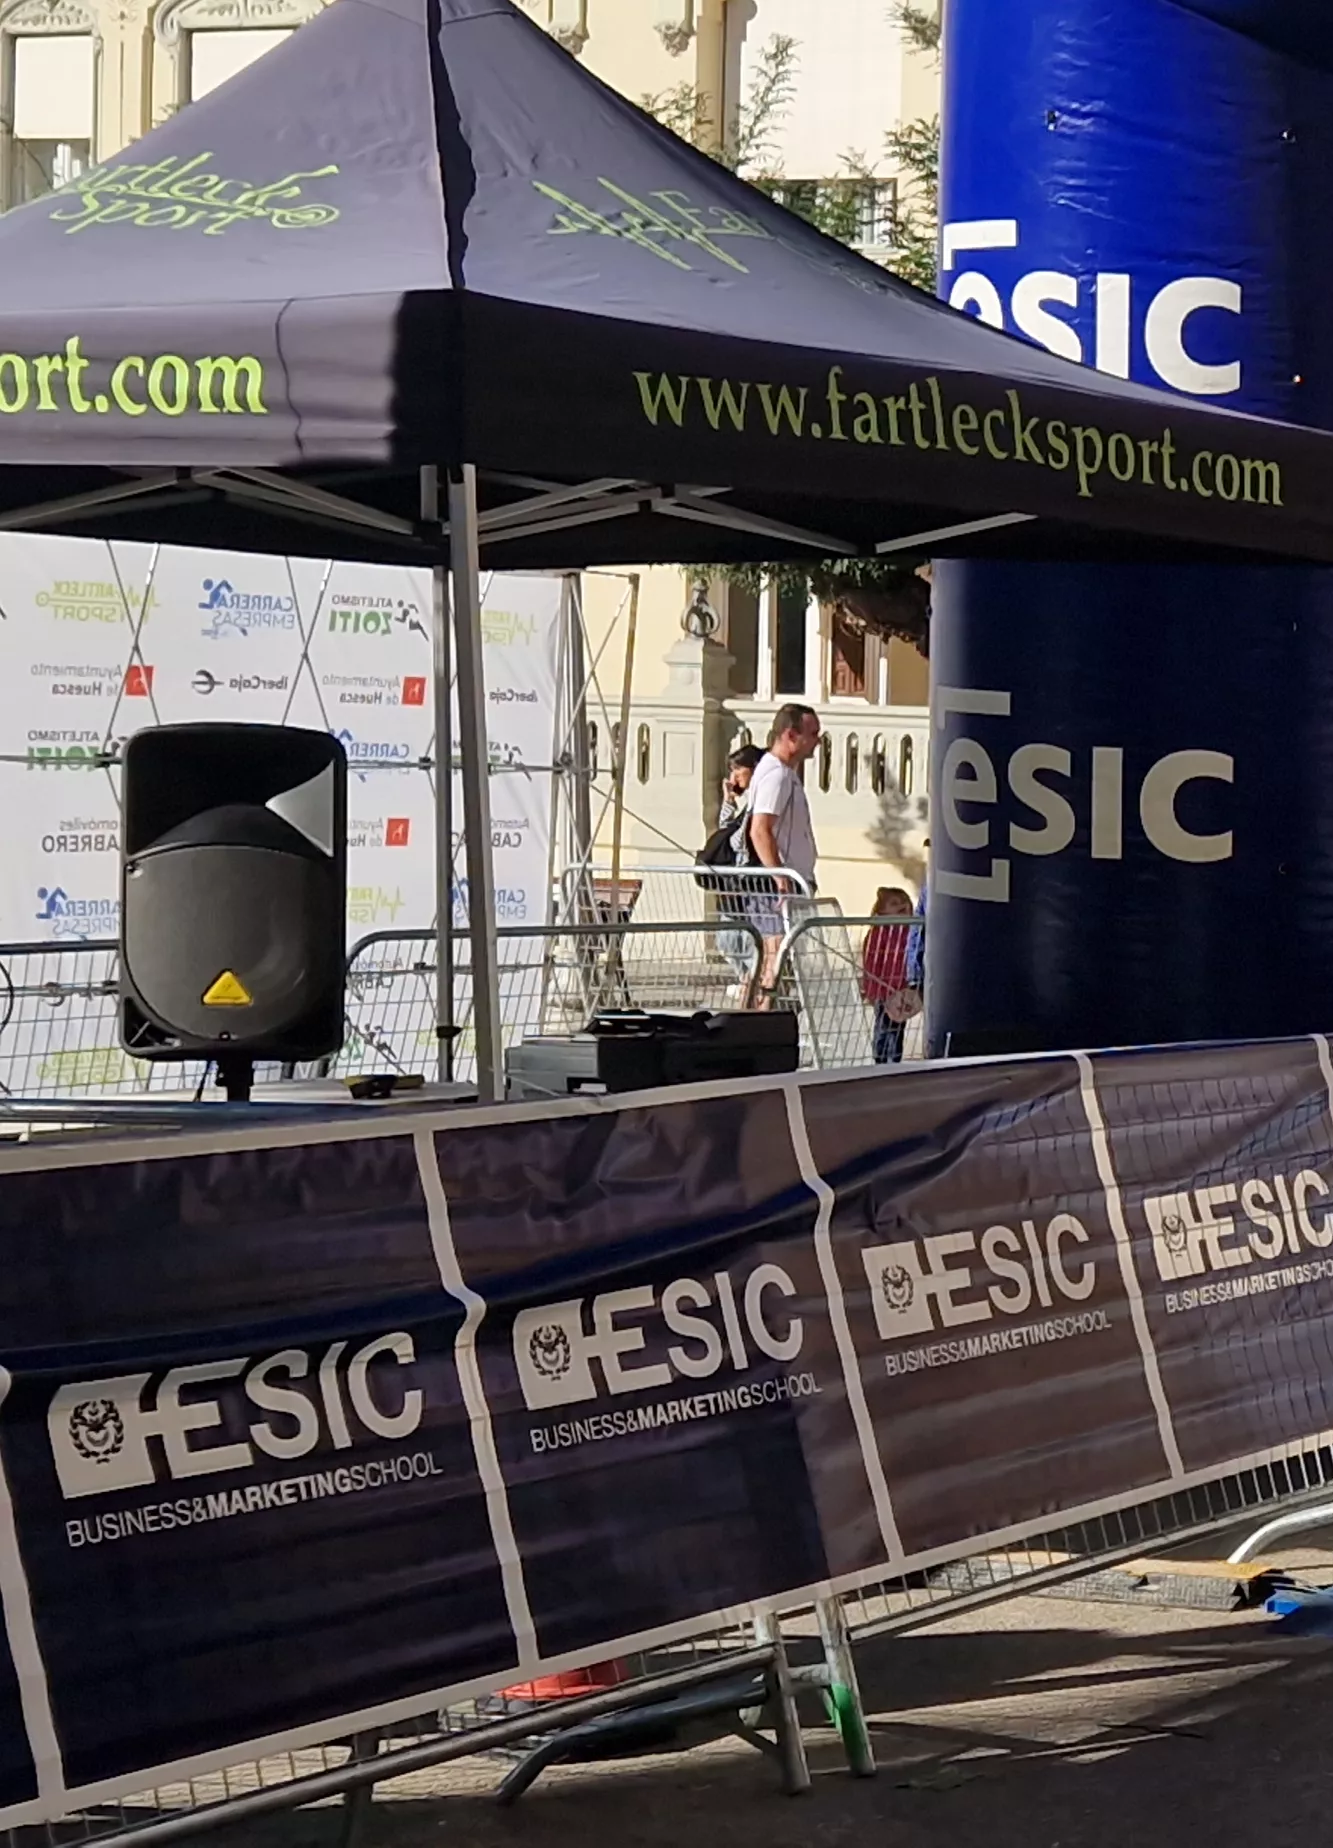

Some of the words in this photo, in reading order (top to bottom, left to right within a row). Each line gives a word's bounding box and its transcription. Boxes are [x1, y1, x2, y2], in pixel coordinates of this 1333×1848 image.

[632, 365, 1285, 506] www.fartlecksport.com
[922, 1213, 1096, 1328] ESIC
[592, 1262, 804, 1396] ESIC
[884, 1310, 1112, 1377] BUSINESS&MARKETINGSCHOOL
[157, 1331, 424, 1480] ESIC
[530, 1372, 824, 1453] BUSINESS&MARKETINGSCHOOL
[65, 1451, 443, 1548] BUSINESS&MARKETINGSCHOOL
